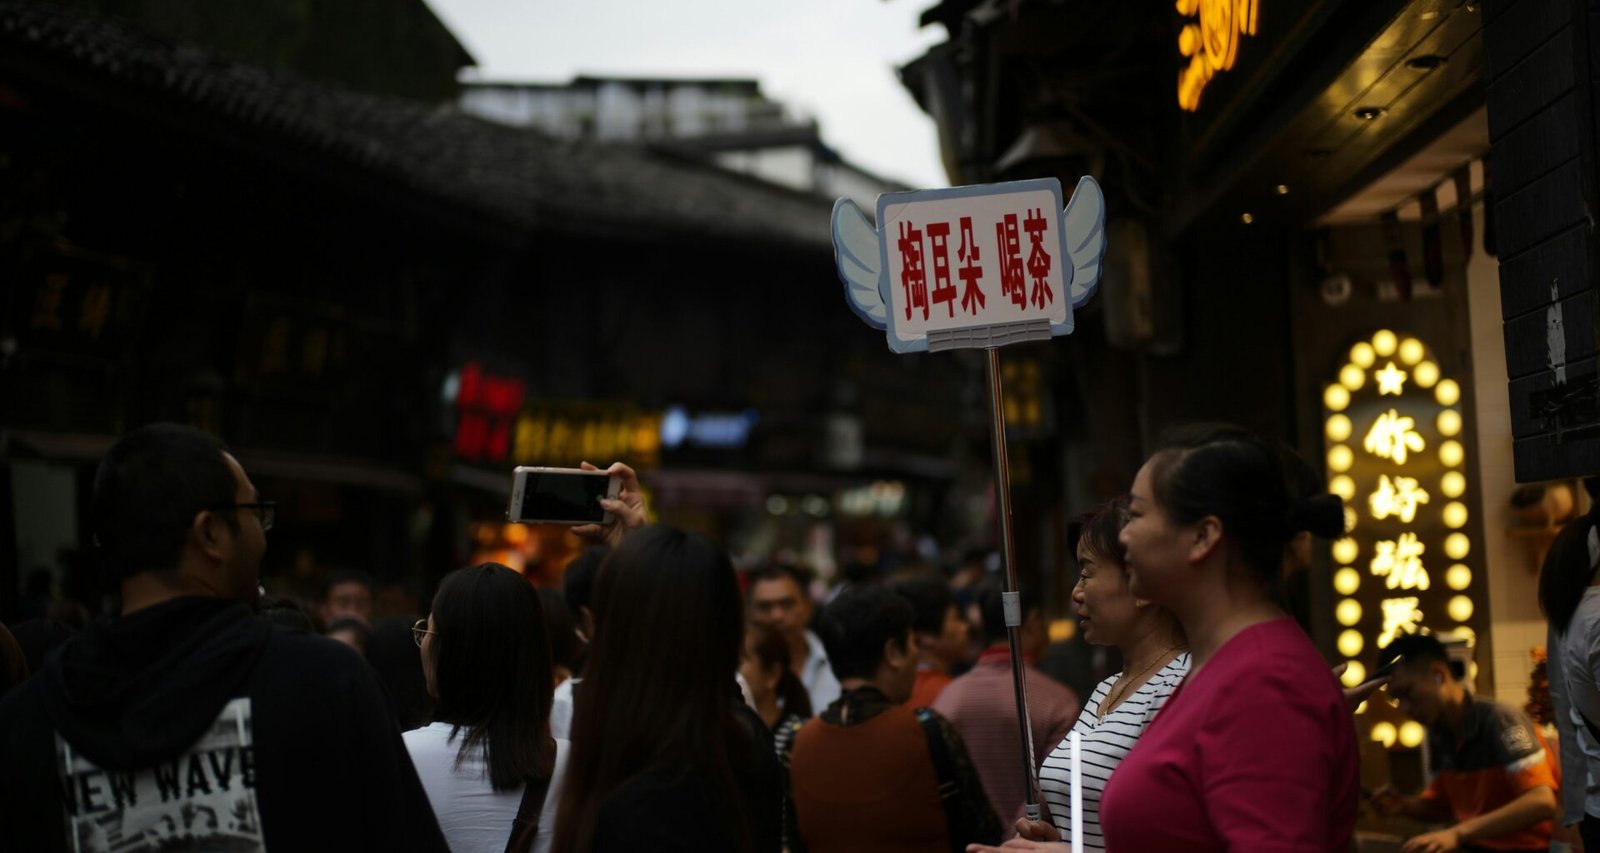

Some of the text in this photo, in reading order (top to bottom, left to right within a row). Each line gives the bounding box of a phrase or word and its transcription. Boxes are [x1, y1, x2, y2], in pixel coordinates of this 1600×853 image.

[898, 207, 1054, 322] 掏耳朵 喝茶
[60, 746, 257, 816] NEW WAVE
